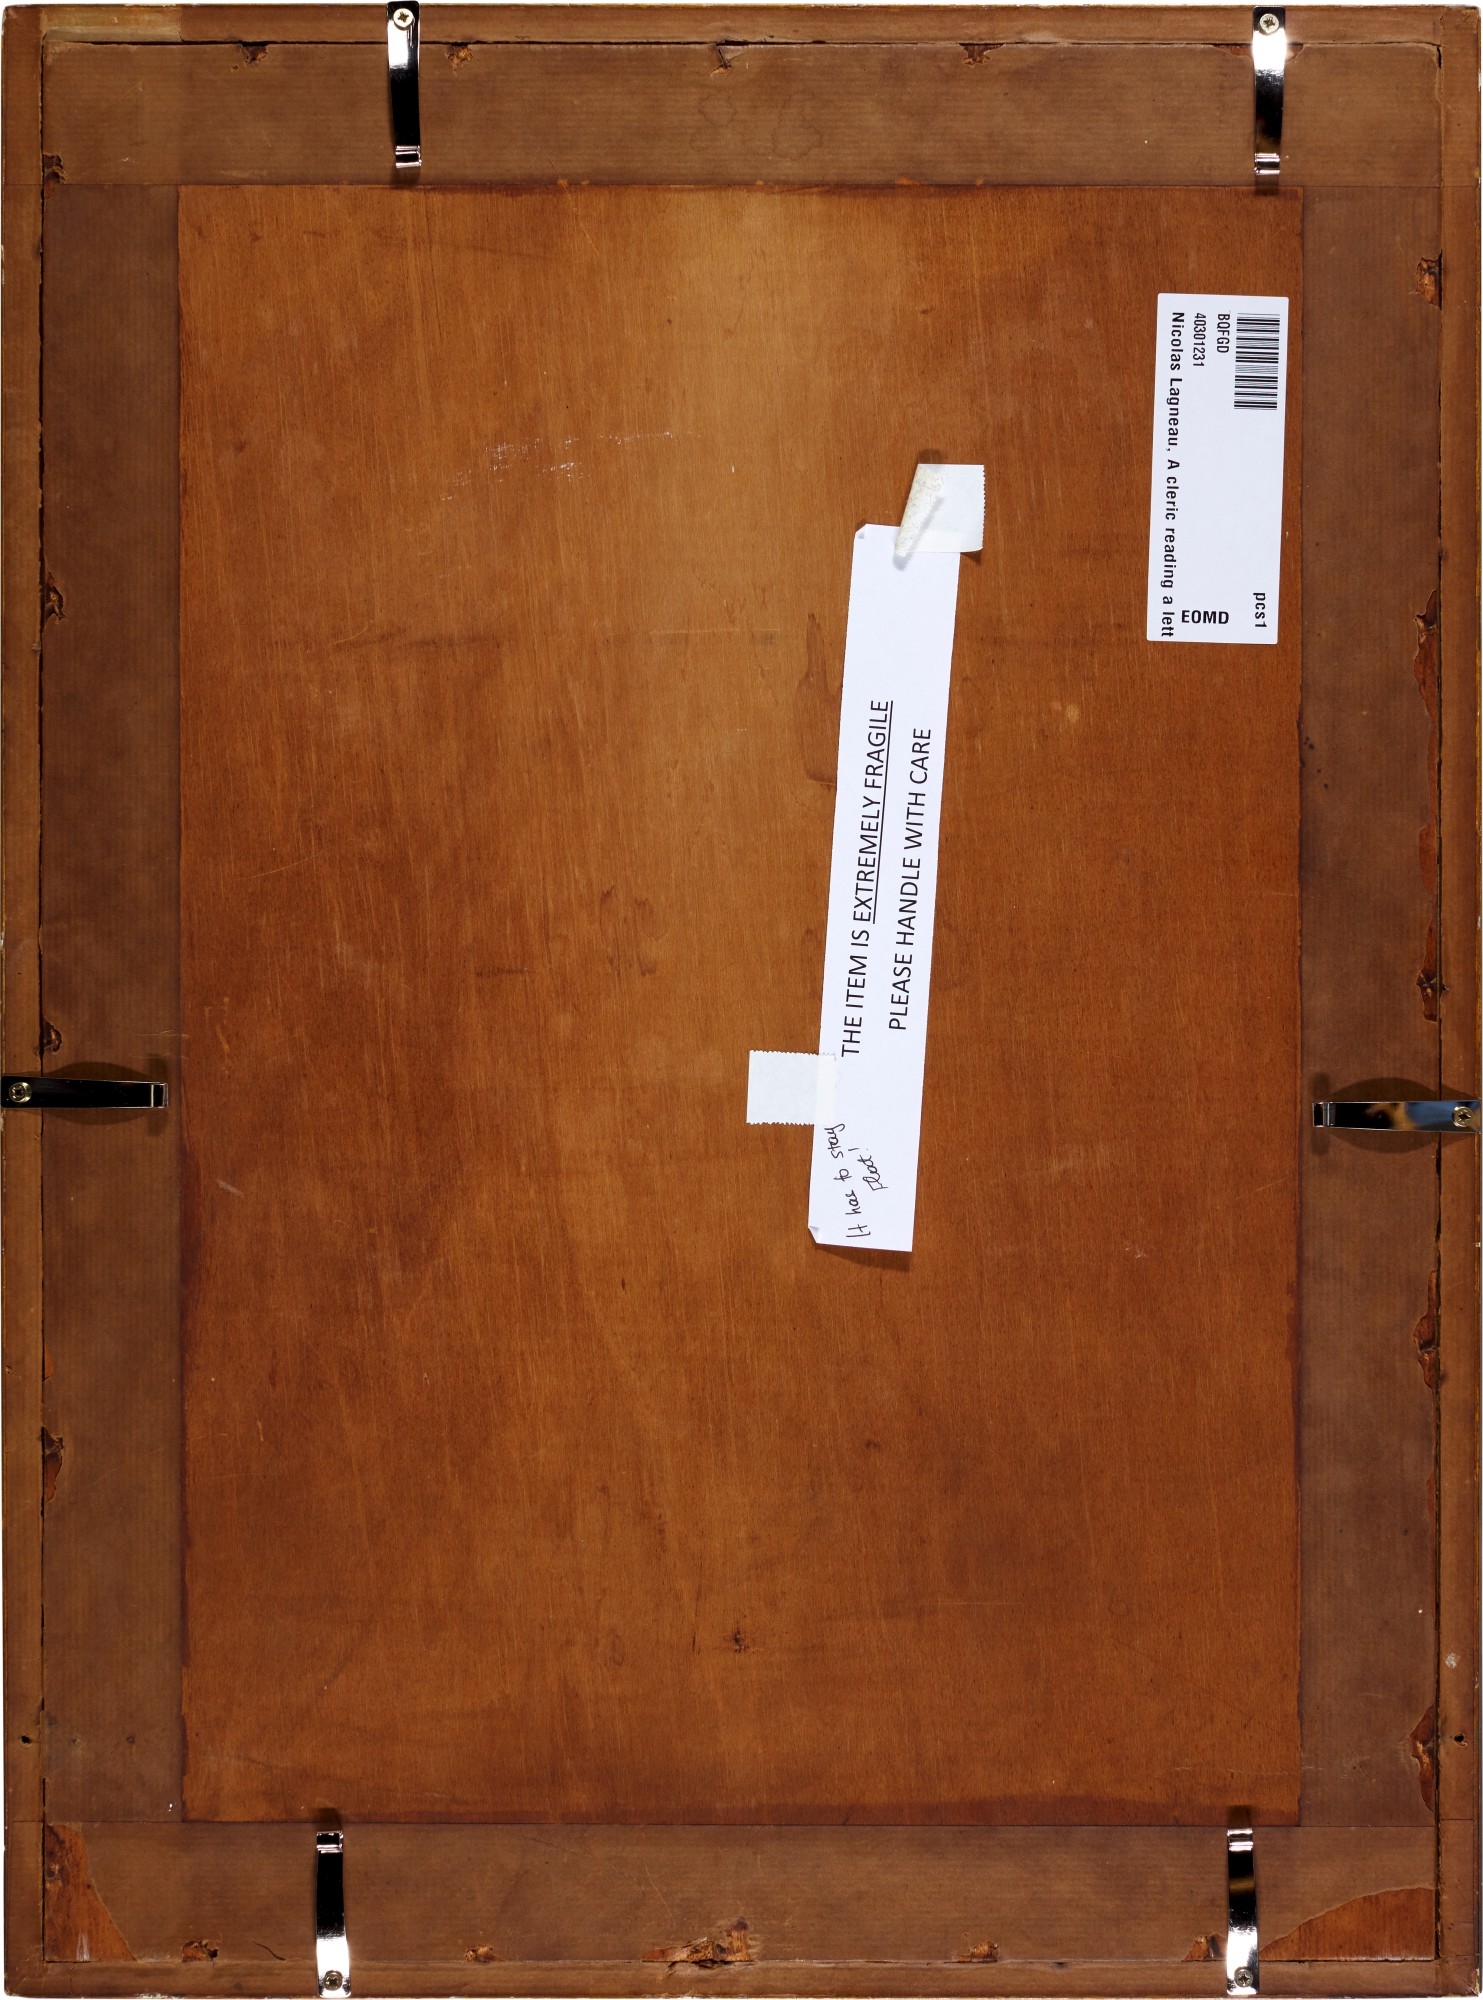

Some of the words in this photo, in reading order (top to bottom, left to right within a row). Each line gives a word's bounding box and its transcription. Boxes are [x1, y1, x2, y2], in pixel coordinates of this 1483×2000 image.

[1169, 311, 1185, 371] Nicolas
[1192, 312, 1207, 367] 40301231
[1216, 313, 1230, 354] BQFGD
[1166, 378, 1183, 452] Lagneau,
[1167, 459, 1180, 470] A
[1165, 476, 1179, 520] cleric
[1160, 528, 1177, 589] reading
[1162, 596, 1173, 605] a
[1181, 610, 1230, 625] EOMD
[1253, 592, 1267, 628] pcs1
[1161, 611, 1175, 637] lett
[864, 700, 889, 789] FRAGILE
[909, 728, 931, 785] CARE
[903, 792, 926, 850] WITH
[853, 795, 881, 922] EXTREMELY
[895, 857, 921, 946] HANDLE
[850, 929, 870, 947] IS
[845, 955, 868, 1008] ITEM
[888, 953, 913, 1030] PLEASE
[841, 1015, 862, 1057] THE
[824, 1123, 846, 1159] stay
[834, 1168, 852, 1182] to
[845, 1189, 862, 1215] has
[846, 1223, 871, 1238] It
